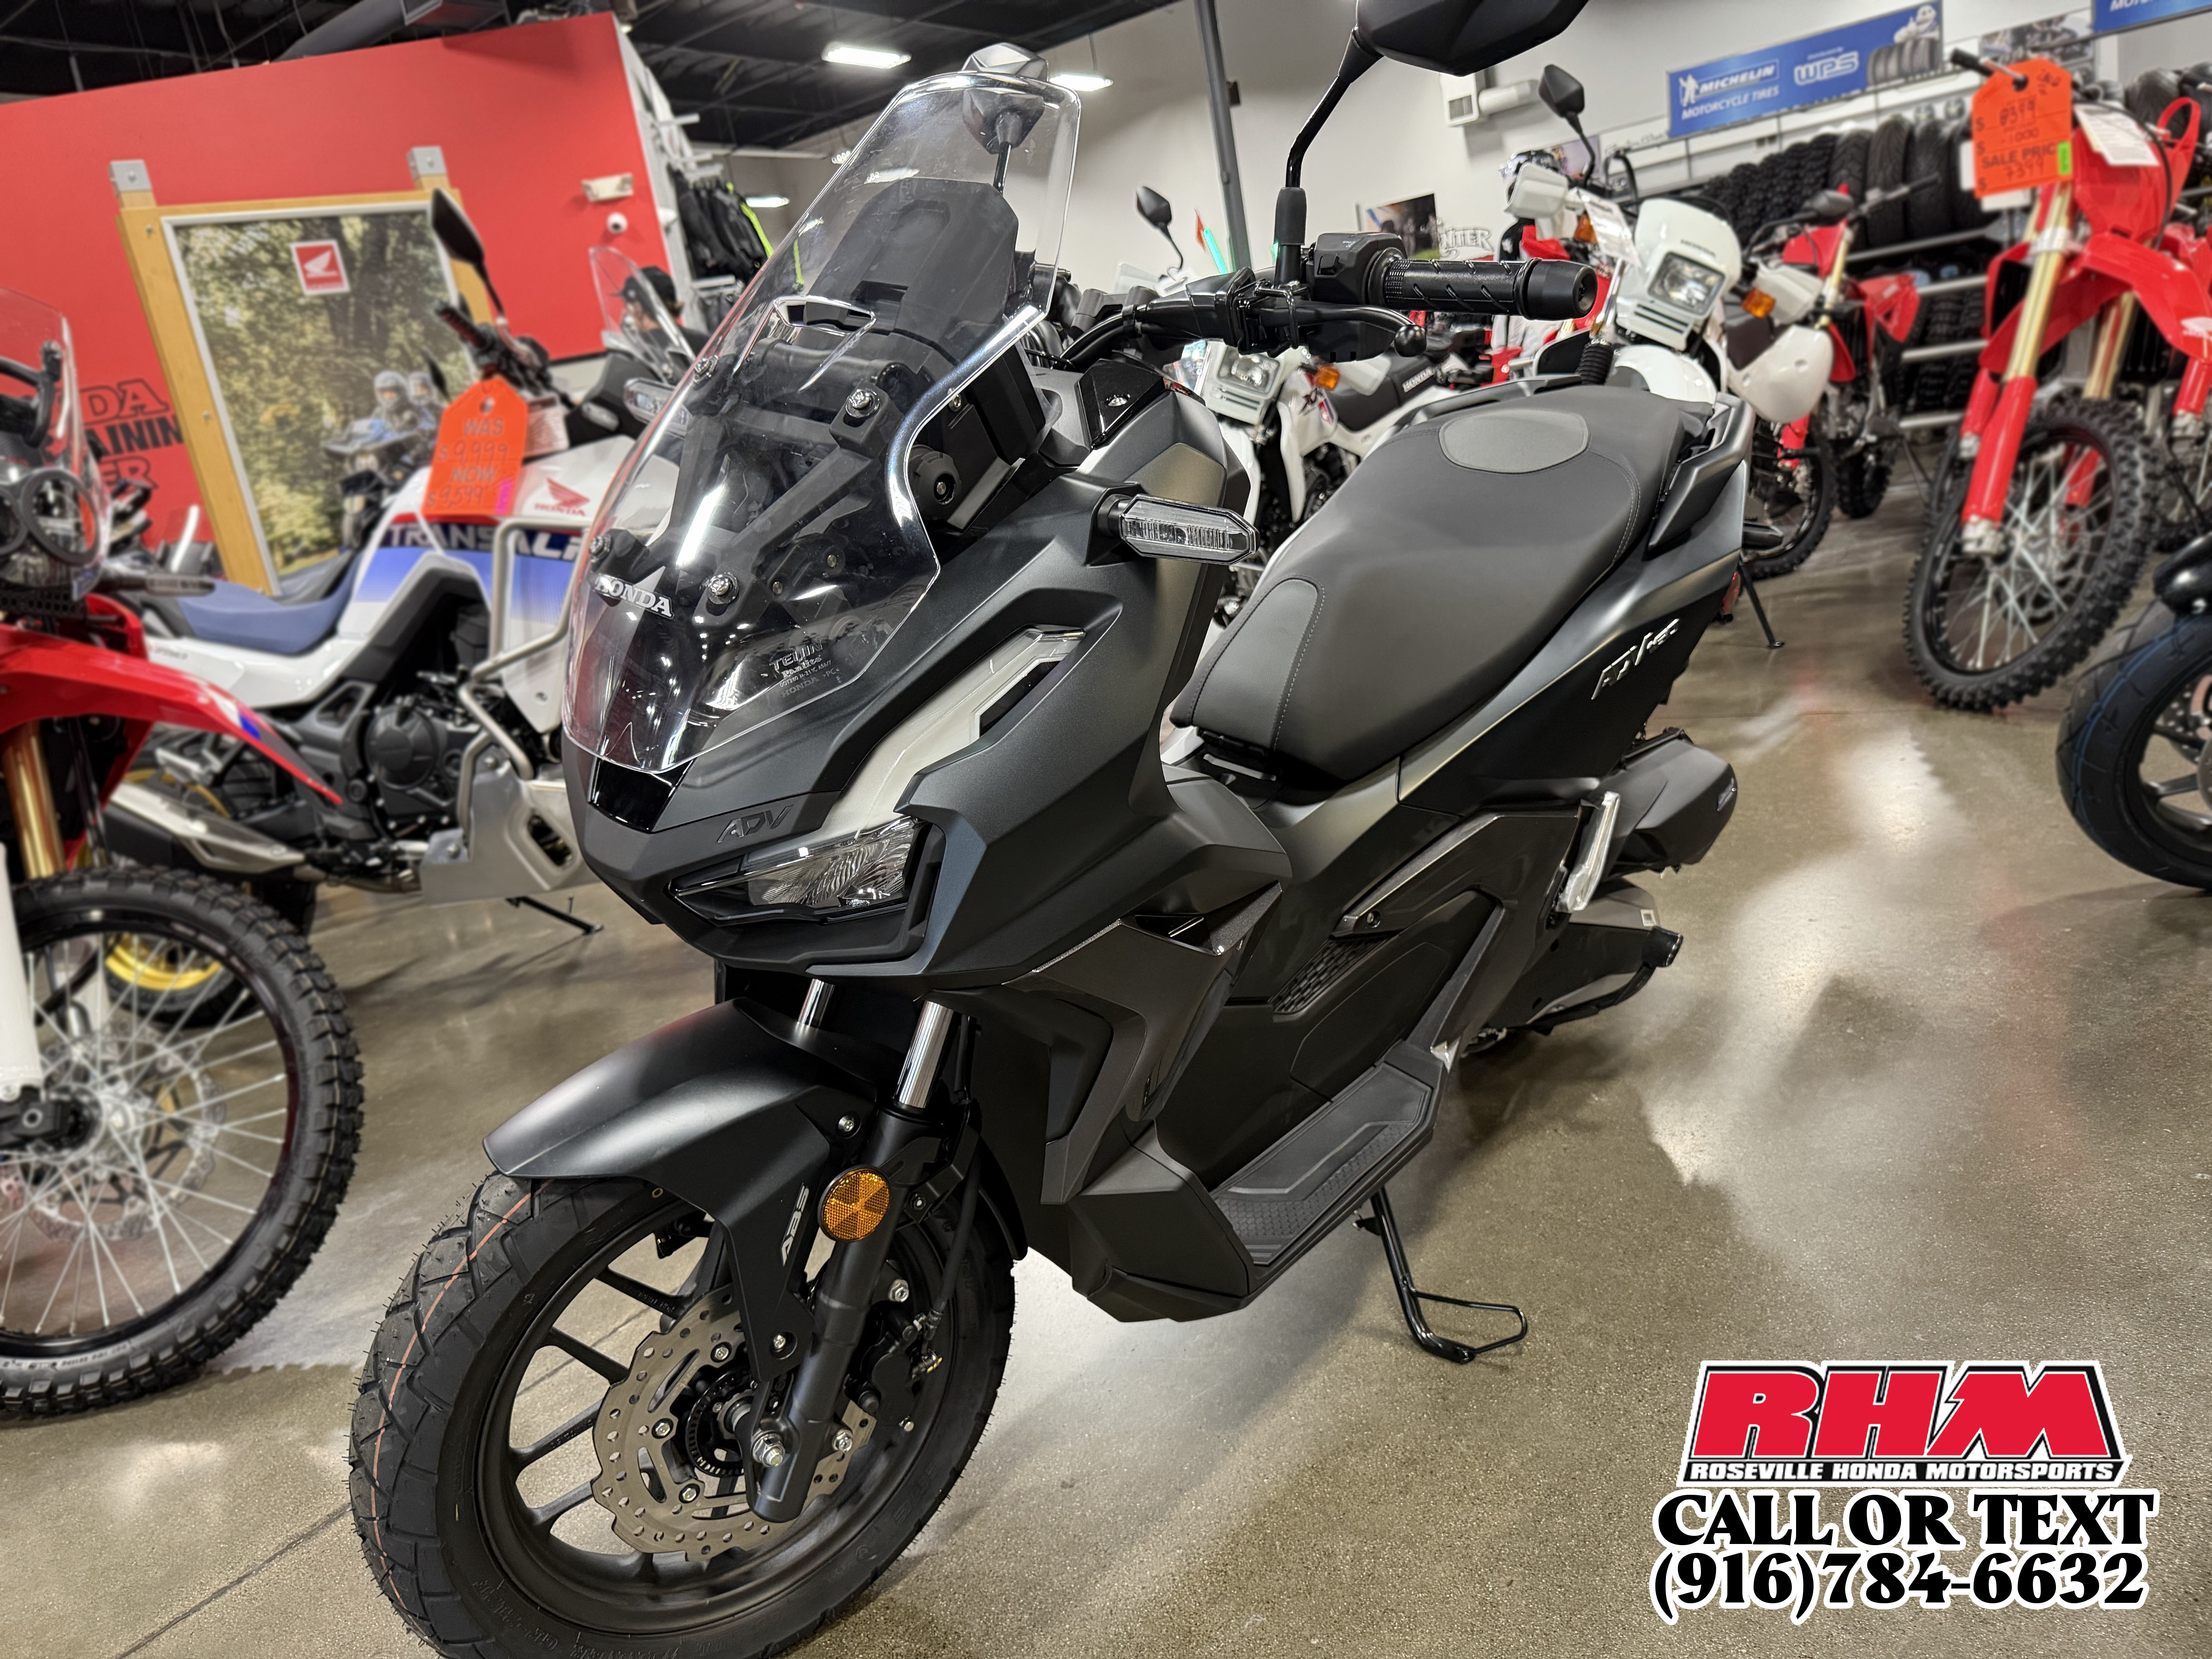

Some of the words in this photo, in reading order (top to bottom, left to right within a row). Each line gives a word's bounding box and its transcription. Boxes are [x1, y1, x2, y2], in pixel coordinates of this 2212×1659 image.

[1699, 64, 1775, 94] MICHELIN
[1794, 50, 1859, 86] WPS
[1681, 93, 1749, 120] MOTORCYCLE
[1752, 84, 1780, 101] TIRES
[1982, 150, 2017, 169] SALE
[2022, 142, 2057, 160] PRIC
[463, 416, 505, 436] WAS
[450, 465, 499, 484] NOW
[594, 575, 672, 617] HONDA
[769, 639, 823, 672] TEIJIN
[781, 677, 820, 697] HONDA
[717, 804, 794, 843] ADV
[780, 1182, 810, 1266] ABS
